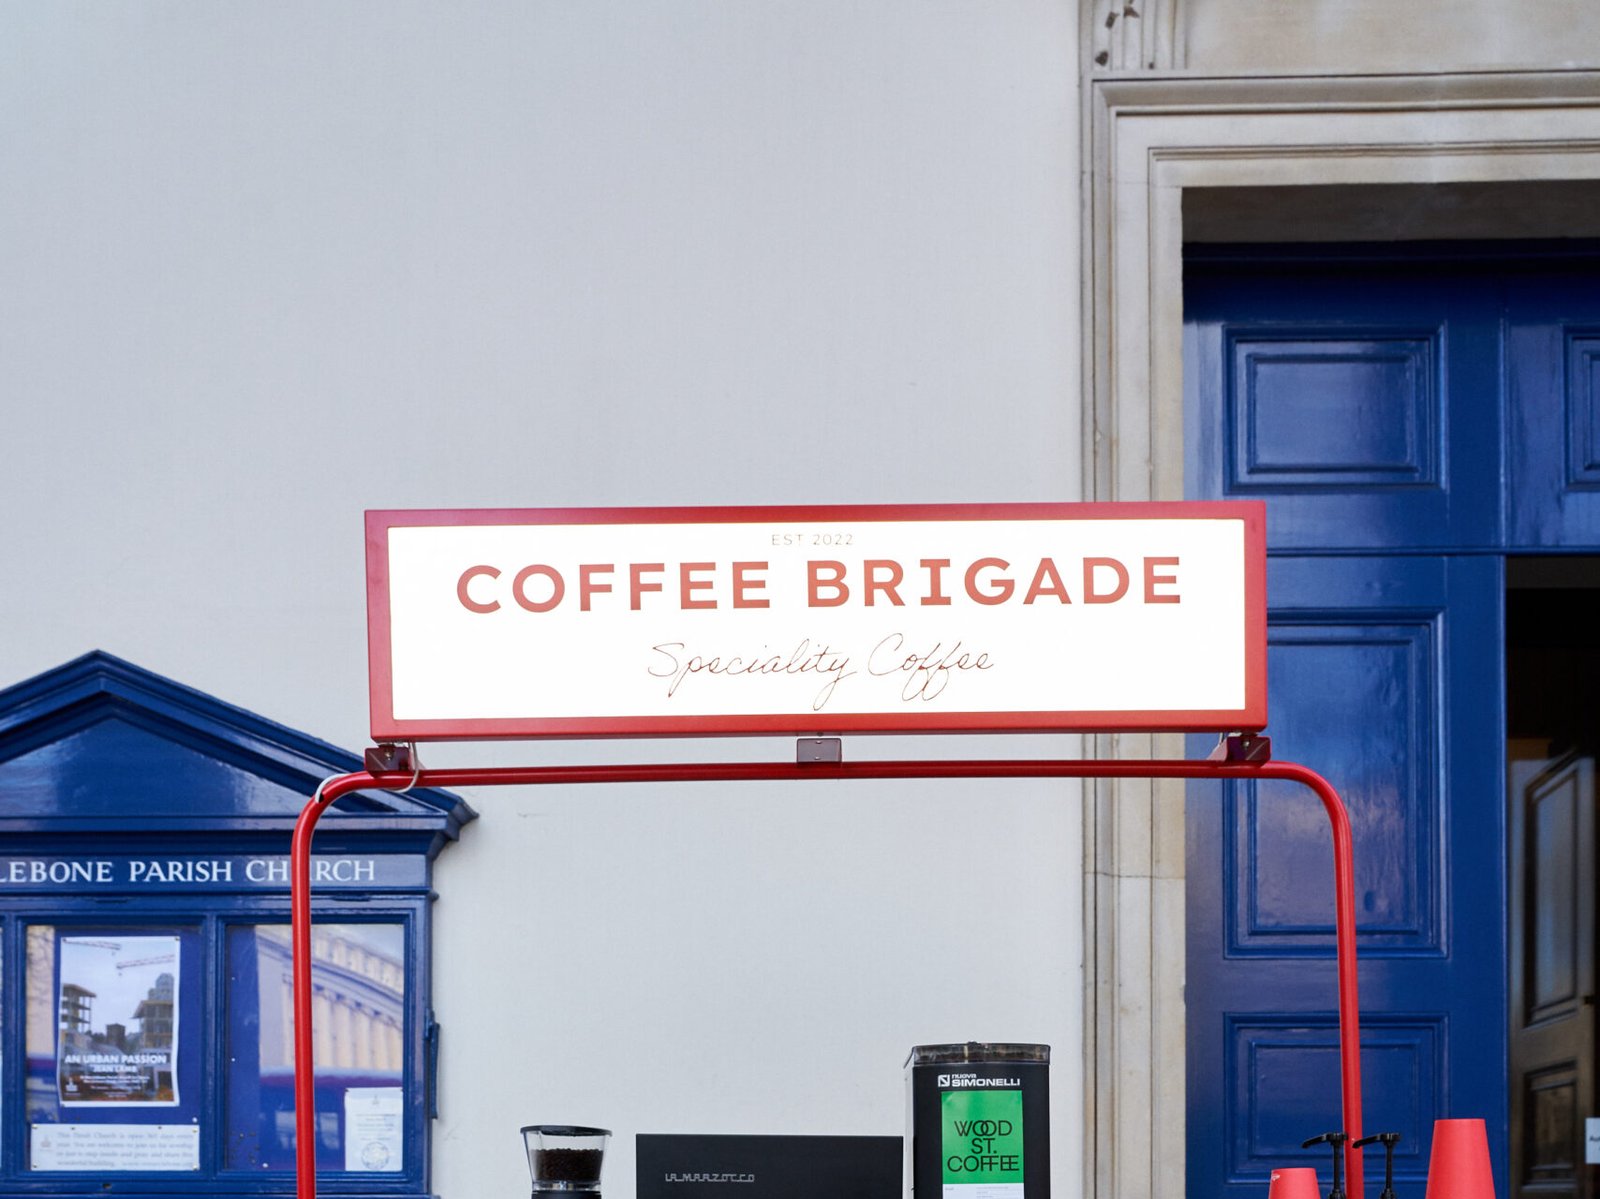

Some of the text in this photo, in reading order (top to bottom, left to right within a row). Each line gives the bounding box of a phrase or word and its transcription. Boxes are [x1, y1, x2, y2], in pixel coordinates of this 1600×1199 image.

[771, 533, 854, 546] EST 2022
[456, 556, 1181, 614] COFFEE BRIGADE
[648, 633, 994, 711] Speciality Coffee
[128, 860, 232, 882] PARISH
[245, 859, 375, 882] CHRCH
[64, 1054, 167, 1063] AN URBAN PASSION
[951, 1079, 1020, 1087] SIMONELLI
[954, 1119, 1013, 1137] WOOD
[971, 1138, 997, 1154] ST.
[947, 1155, 1019, 1173] COFFEE
